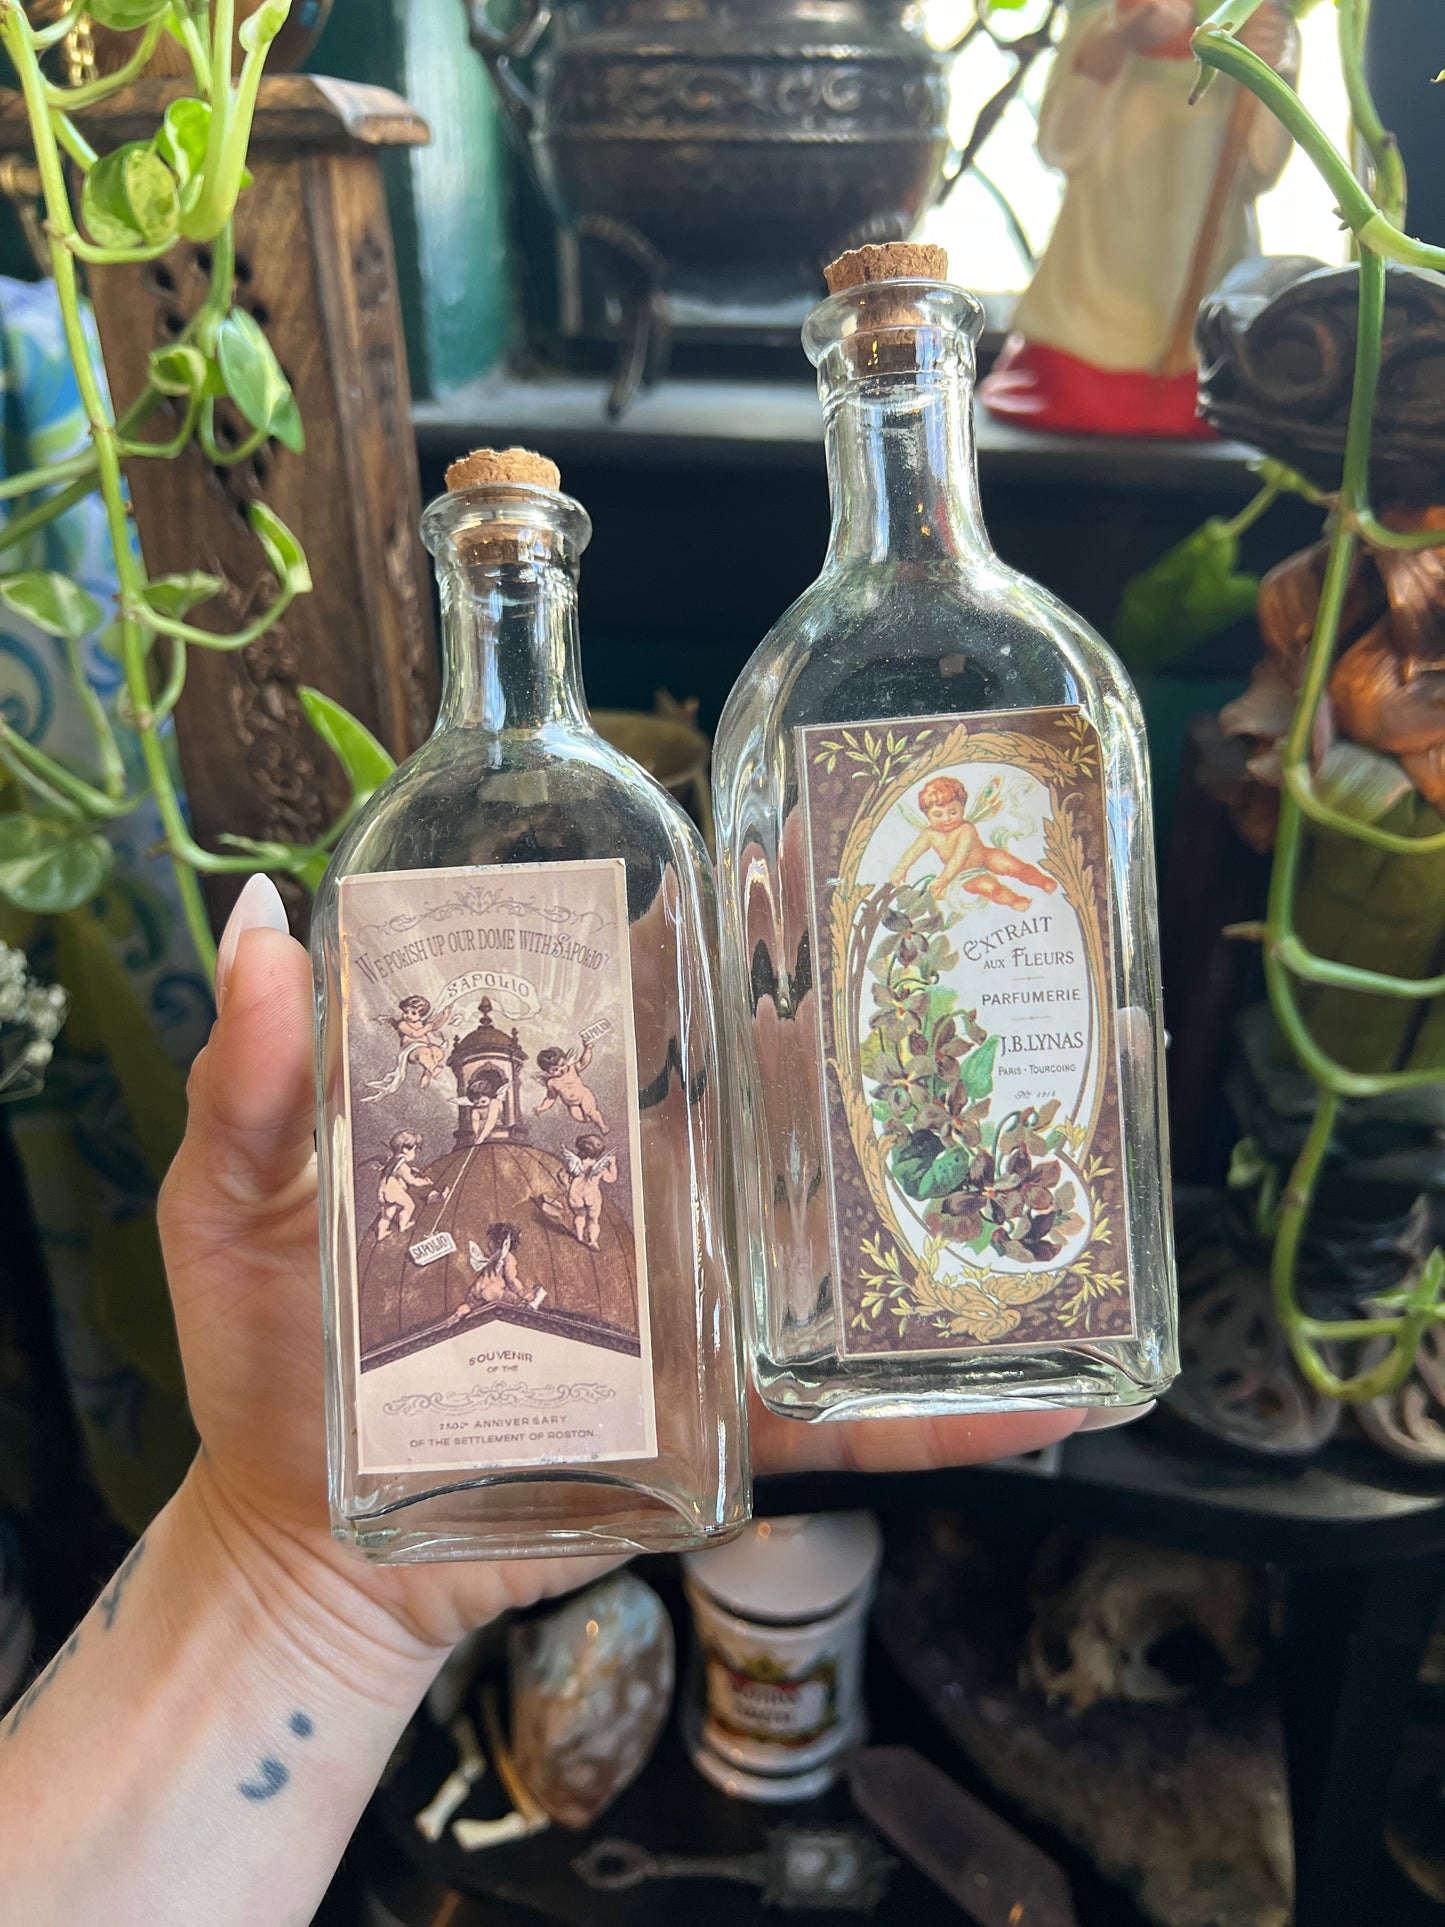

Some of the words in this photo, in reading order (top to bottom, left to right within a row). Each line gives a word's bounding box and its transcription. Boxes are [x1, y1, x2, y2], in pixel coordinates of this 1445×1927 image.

[427, 934, 444, 957] UP
[448, 929, 475, 952] OUR
[479, 928, 515, 950] DOME
[519, 930, 552, 955] WITH
[963, 916, 1052, 961] EXTRAIT
[983, 958, 1006, 970] AUX
[1012, 947, 1074, 967] FLEURS
[447, 973, 529, 997] SAPOLIO
[982, 989, 1081, 1006] PARFUMERIE
[469, 1350, 533, 1366] SOUVENIR
[474, 1415, 567, 1429] ANNIVERSARY
[410, 1439, 425, 1448] OF
[428, 1438, 450, 1447] THE
[454, 1433, 524, 1445] SETTLEMENT
[529, 1431, 544, 1441] OF
